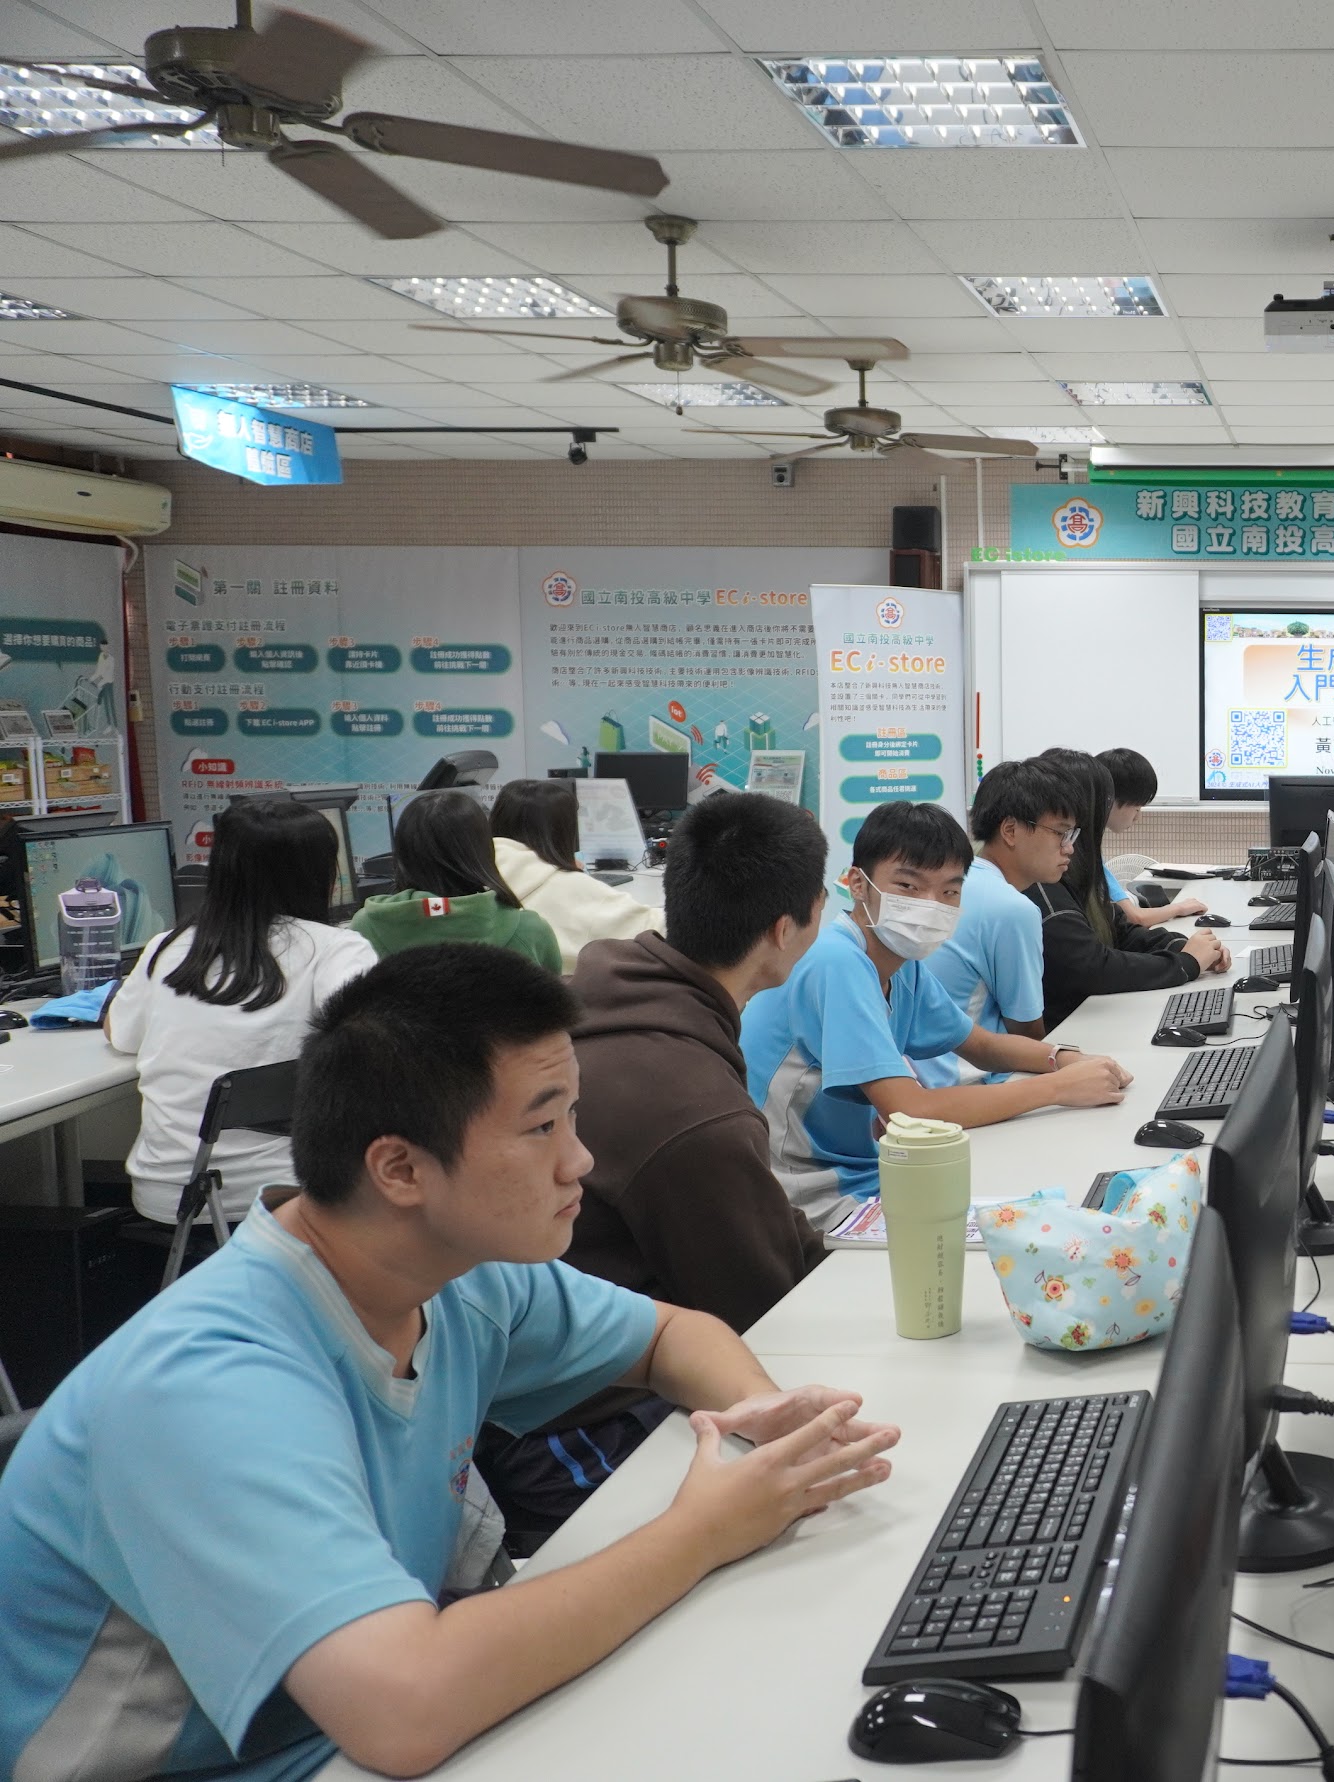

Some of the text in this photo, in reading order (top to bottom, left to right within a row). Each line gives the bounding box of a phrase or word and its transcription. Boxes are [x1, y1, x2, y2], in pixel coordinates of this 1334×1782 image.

[971, 546, 999, 562] EC
[213, 579, 339, 596] 第一關 註冊資料
[581, 589, 711, 606] 國立南投高級中學
[716, 589, 738, 605] EC
[843, 632, 935, 647] 國立南投高級中學
[830, 650, 946, 674] EC i-store
[168, 683, 265, 696] 行動支付註冊流程
[298, 718, 315, 727] APP
[198, 761, 229, 773] 小知識
